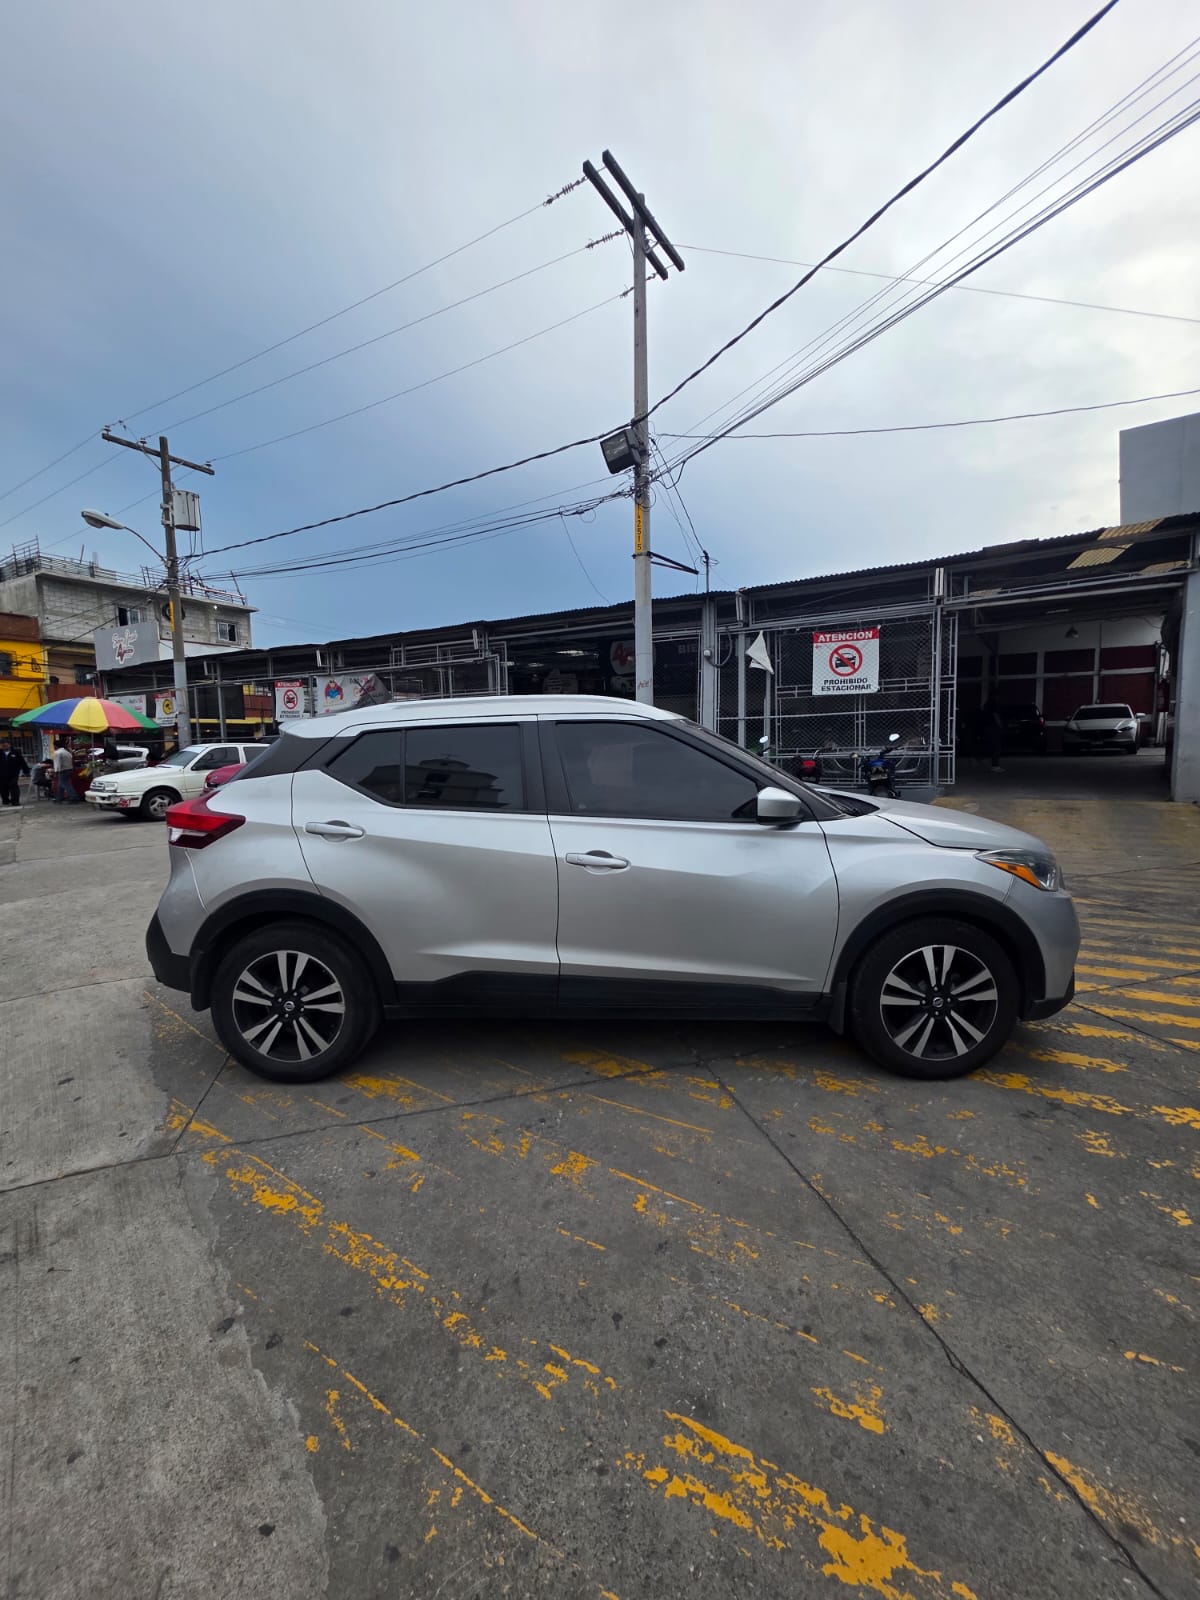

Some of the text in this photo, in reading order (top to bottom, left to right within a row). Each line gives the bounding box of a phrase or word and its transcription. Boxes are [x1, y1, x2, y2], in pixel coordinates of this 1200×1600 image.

[818, 631, 873, 642] ATENCION
[823, 677, 868, 685] PROHIBIDO
[821, 684, 871, 692] ESTACIONAR
